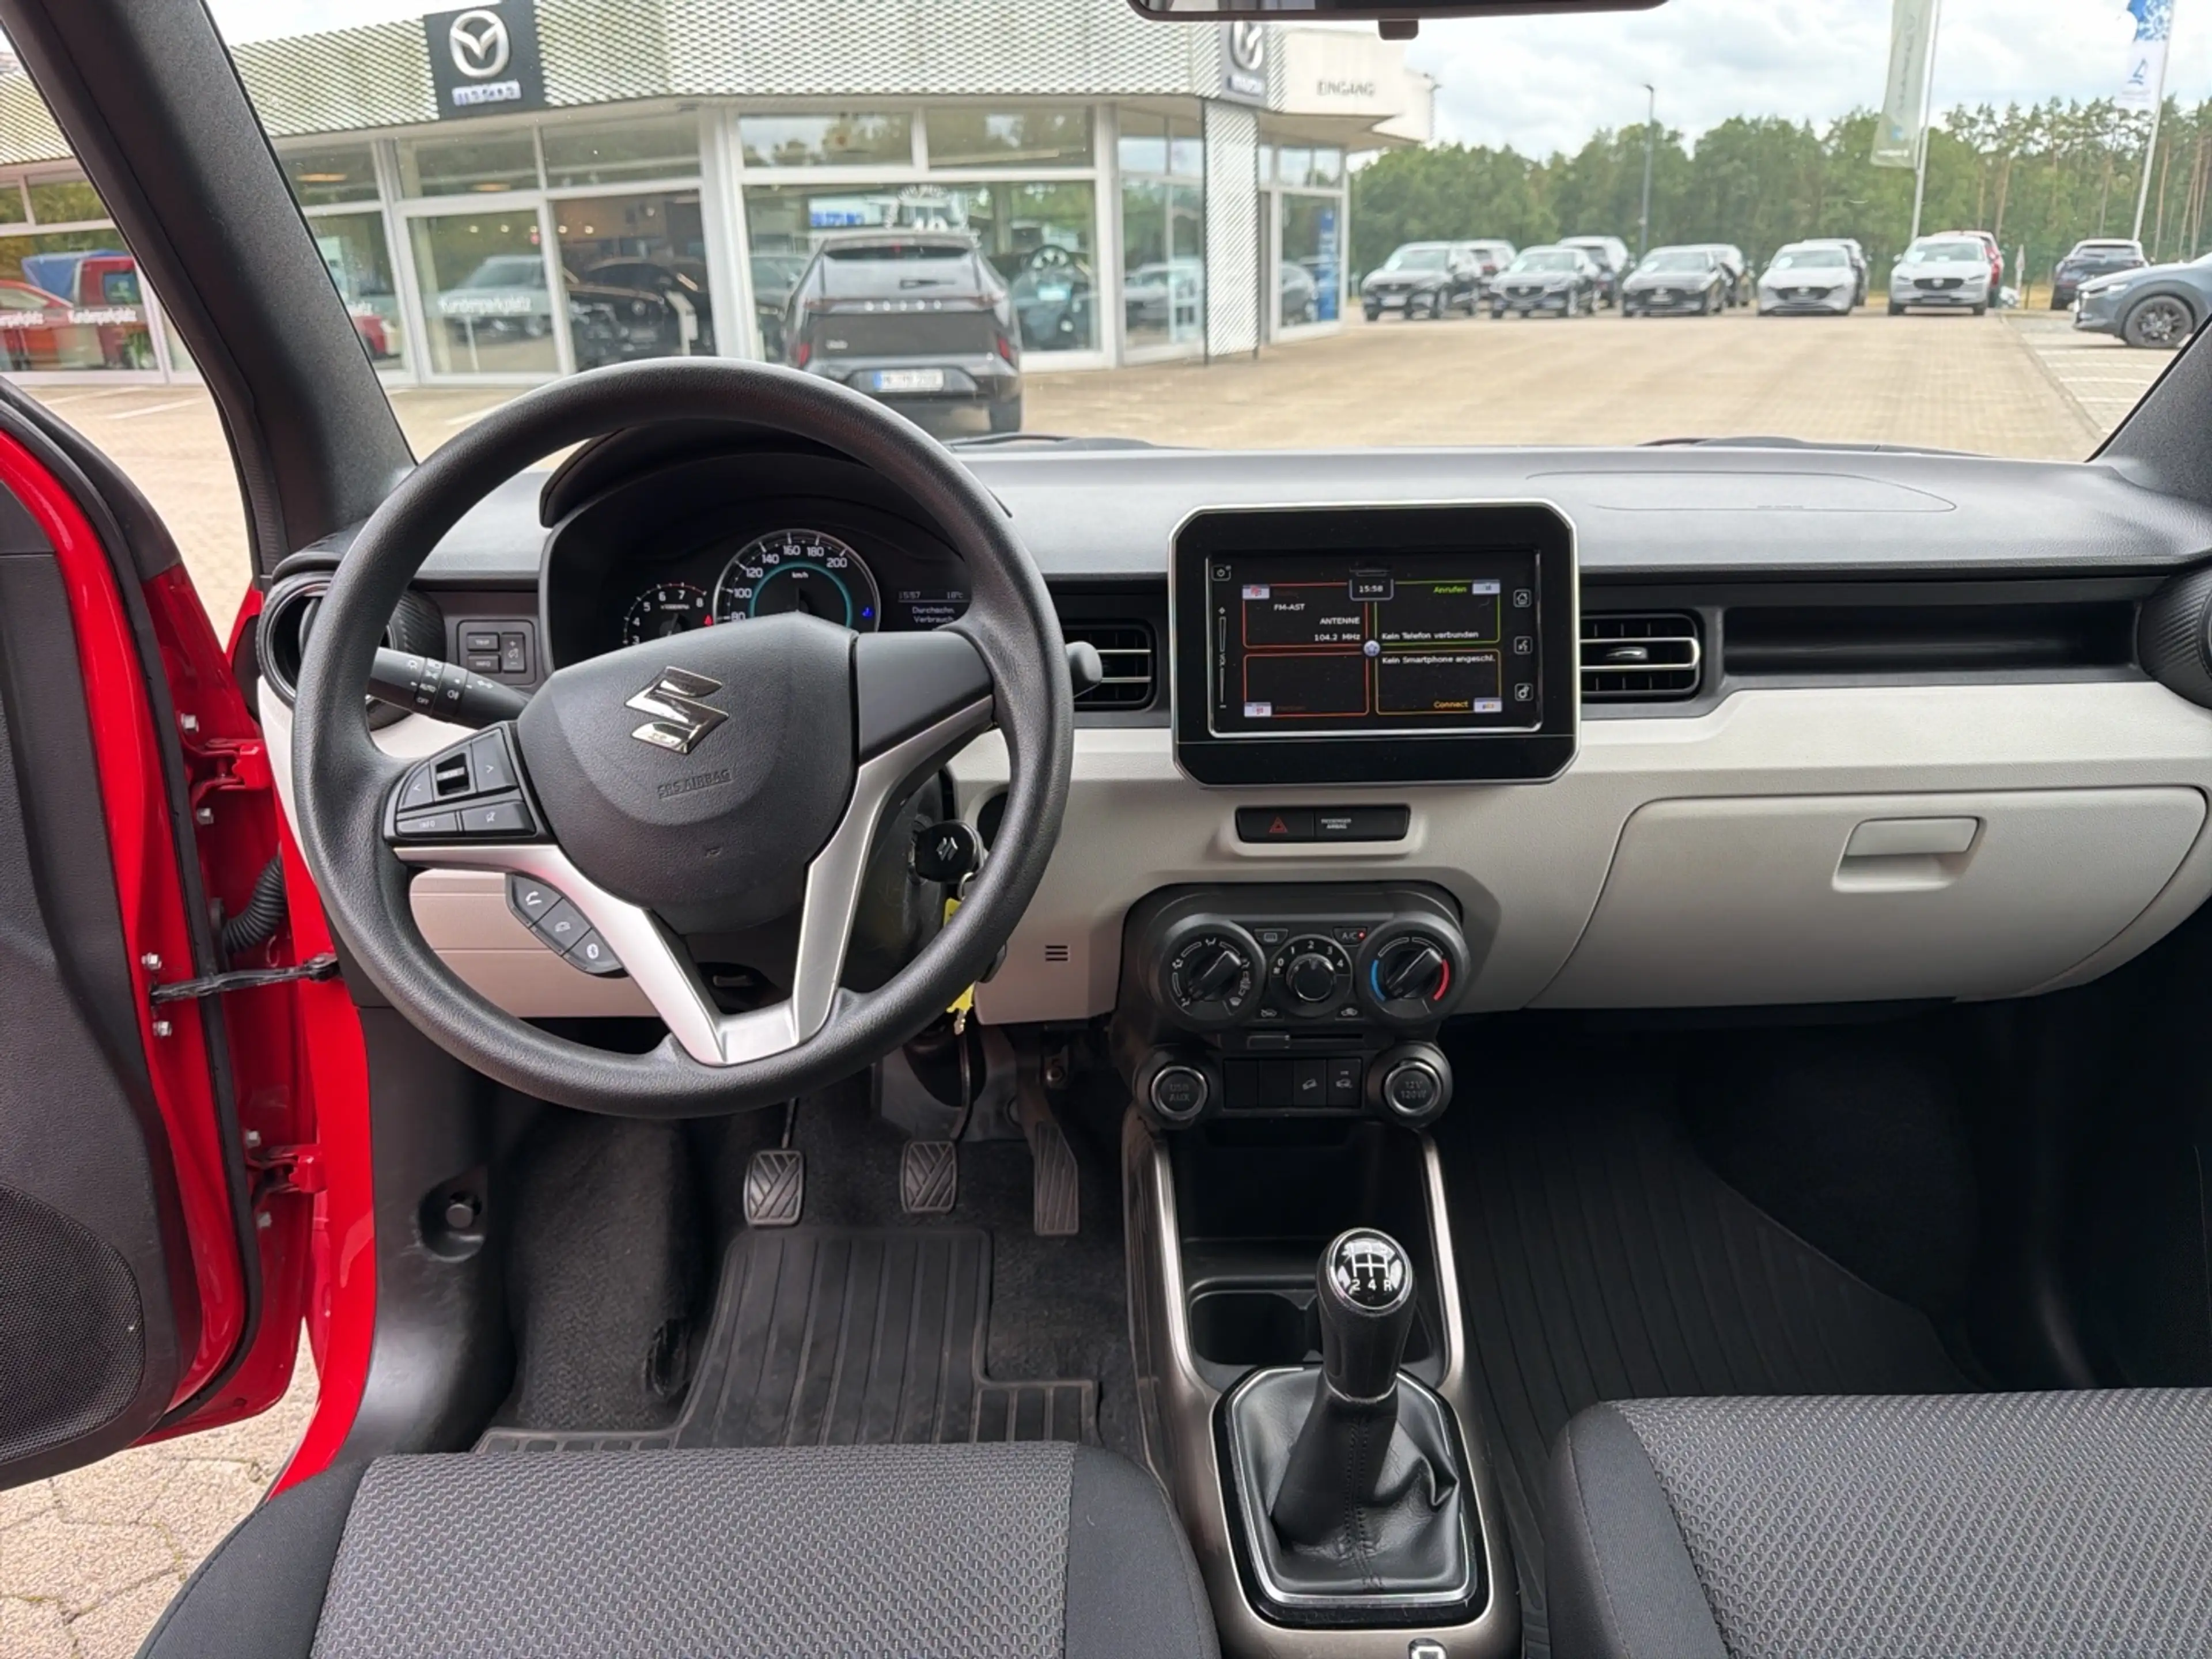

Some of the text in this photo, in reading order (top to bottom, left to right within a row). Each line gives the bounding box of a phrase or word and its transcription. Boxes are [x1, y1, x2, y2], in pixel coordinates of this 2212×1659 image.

[783, 546, 801, 555] 160
[806, 547, 824, 556] 180
[762, 554, 779, 564] 140
[826, 558, 847, 568] 200
[745, 567, 763, 578] 120
[733, 588, 752, 599] 100
[1359, 585, 1384, 593] 15:58
[1433, 585, 1467, 593] Anrufen
[658, 591, 666, 601] 6
[678, 589, 685, 600] 7
[643, 601, 650, 612] 5
[696, 597, 703, 608] 8
[1274, 603, 1305, 611] FM-AST
[632, 616, 641, 627] 4
[1319, 616, 1361, 625] ANTENNE
[1314, 633, 1361, 642] 104.2 MHz
[1382, 630, 1479, 641] Kein Telefon verbunden
[1382, 653, 1496, 665] Kein Smartphone angeschl.
[1433, 700, 1469, 709] Connect
[1342, 931, 1358, 940] A/C
[1307, 940, 1315, 949] 2
[1290, 946, 1296, 955] 1
[1277, 957, 1285, 967] 0
[1336, 959, 1344, 968] 4
[1351, 1279, 1393, 1292] 2 4 R
